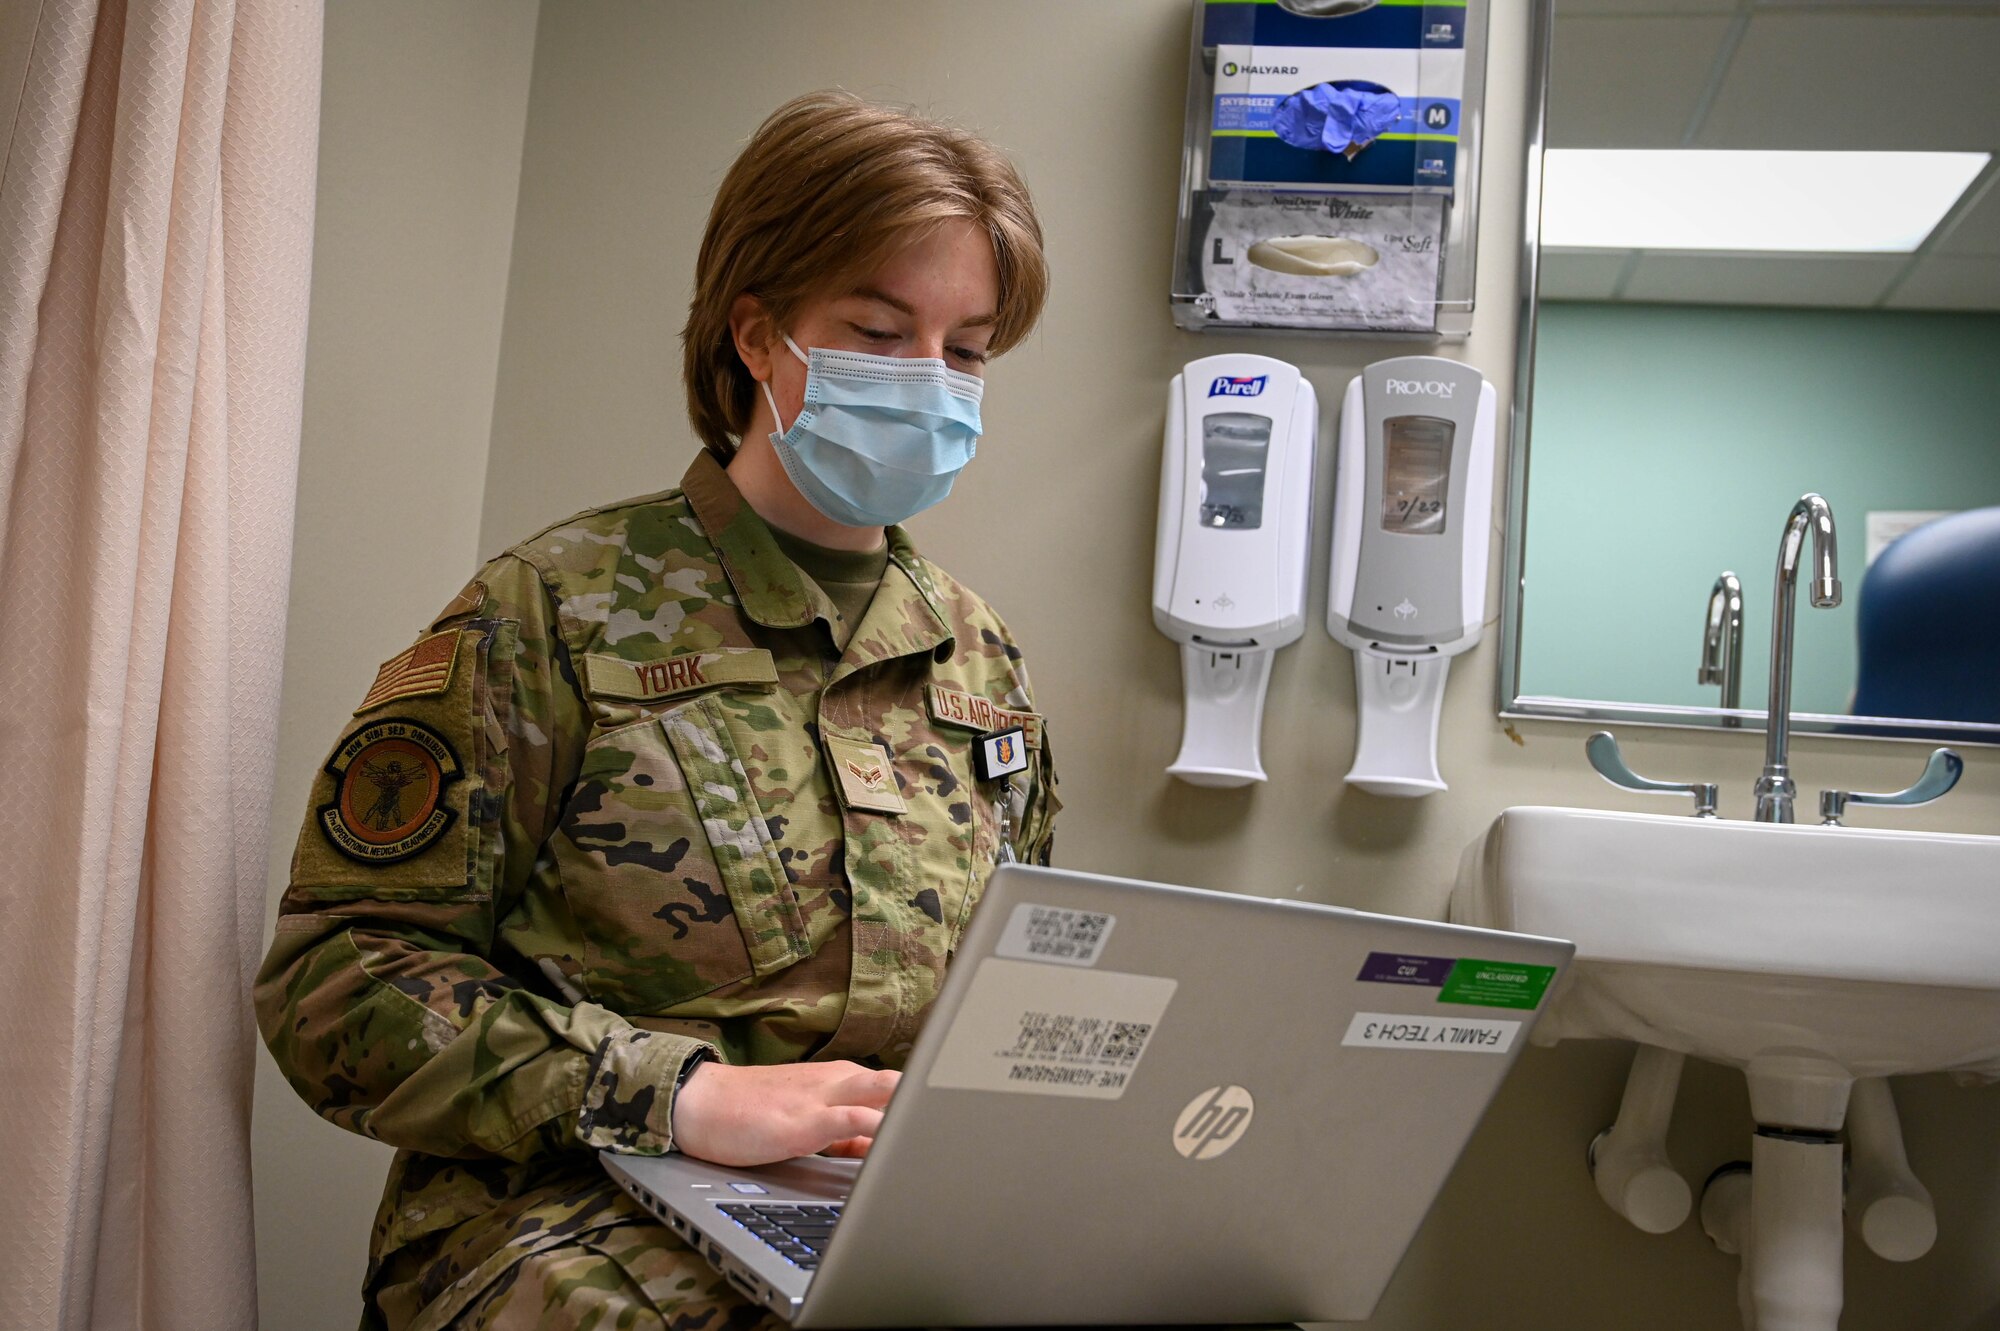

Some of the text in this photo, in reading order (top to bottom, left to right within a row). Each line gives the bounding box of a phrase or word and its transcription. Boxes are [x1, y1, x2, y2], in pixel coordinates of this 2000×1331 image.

[1241, 65, 1299, 75] HALYARD
[1219, 97, 1275, 106] SKYBREEZE
[1428, 108, 1446, 125] M
[1328, 204, 1374, 219] White
[1213, 238, 1234, 264] L
[1403, 235, 1432, 253] Soft
[1214, 378, 1262, 396] Purell
[1386, 378, 1453, 395] PROVON
[635, 656, 706, 695] YORK
[345, 726, 447, 760] NON SIBI SED OMNIBUS
[334, 824, 370, 854] OPERATIONAL
[369, 846, 400, 856] MEDICAL
[401, 825, 437, 851] READINESS
[1475, 971, 1529, 984] UNCLASSIFIED
[1363, 1023, 1502, 1045] FAMILY TECH 3
[1175, 1086, 1252, 1160] hp
